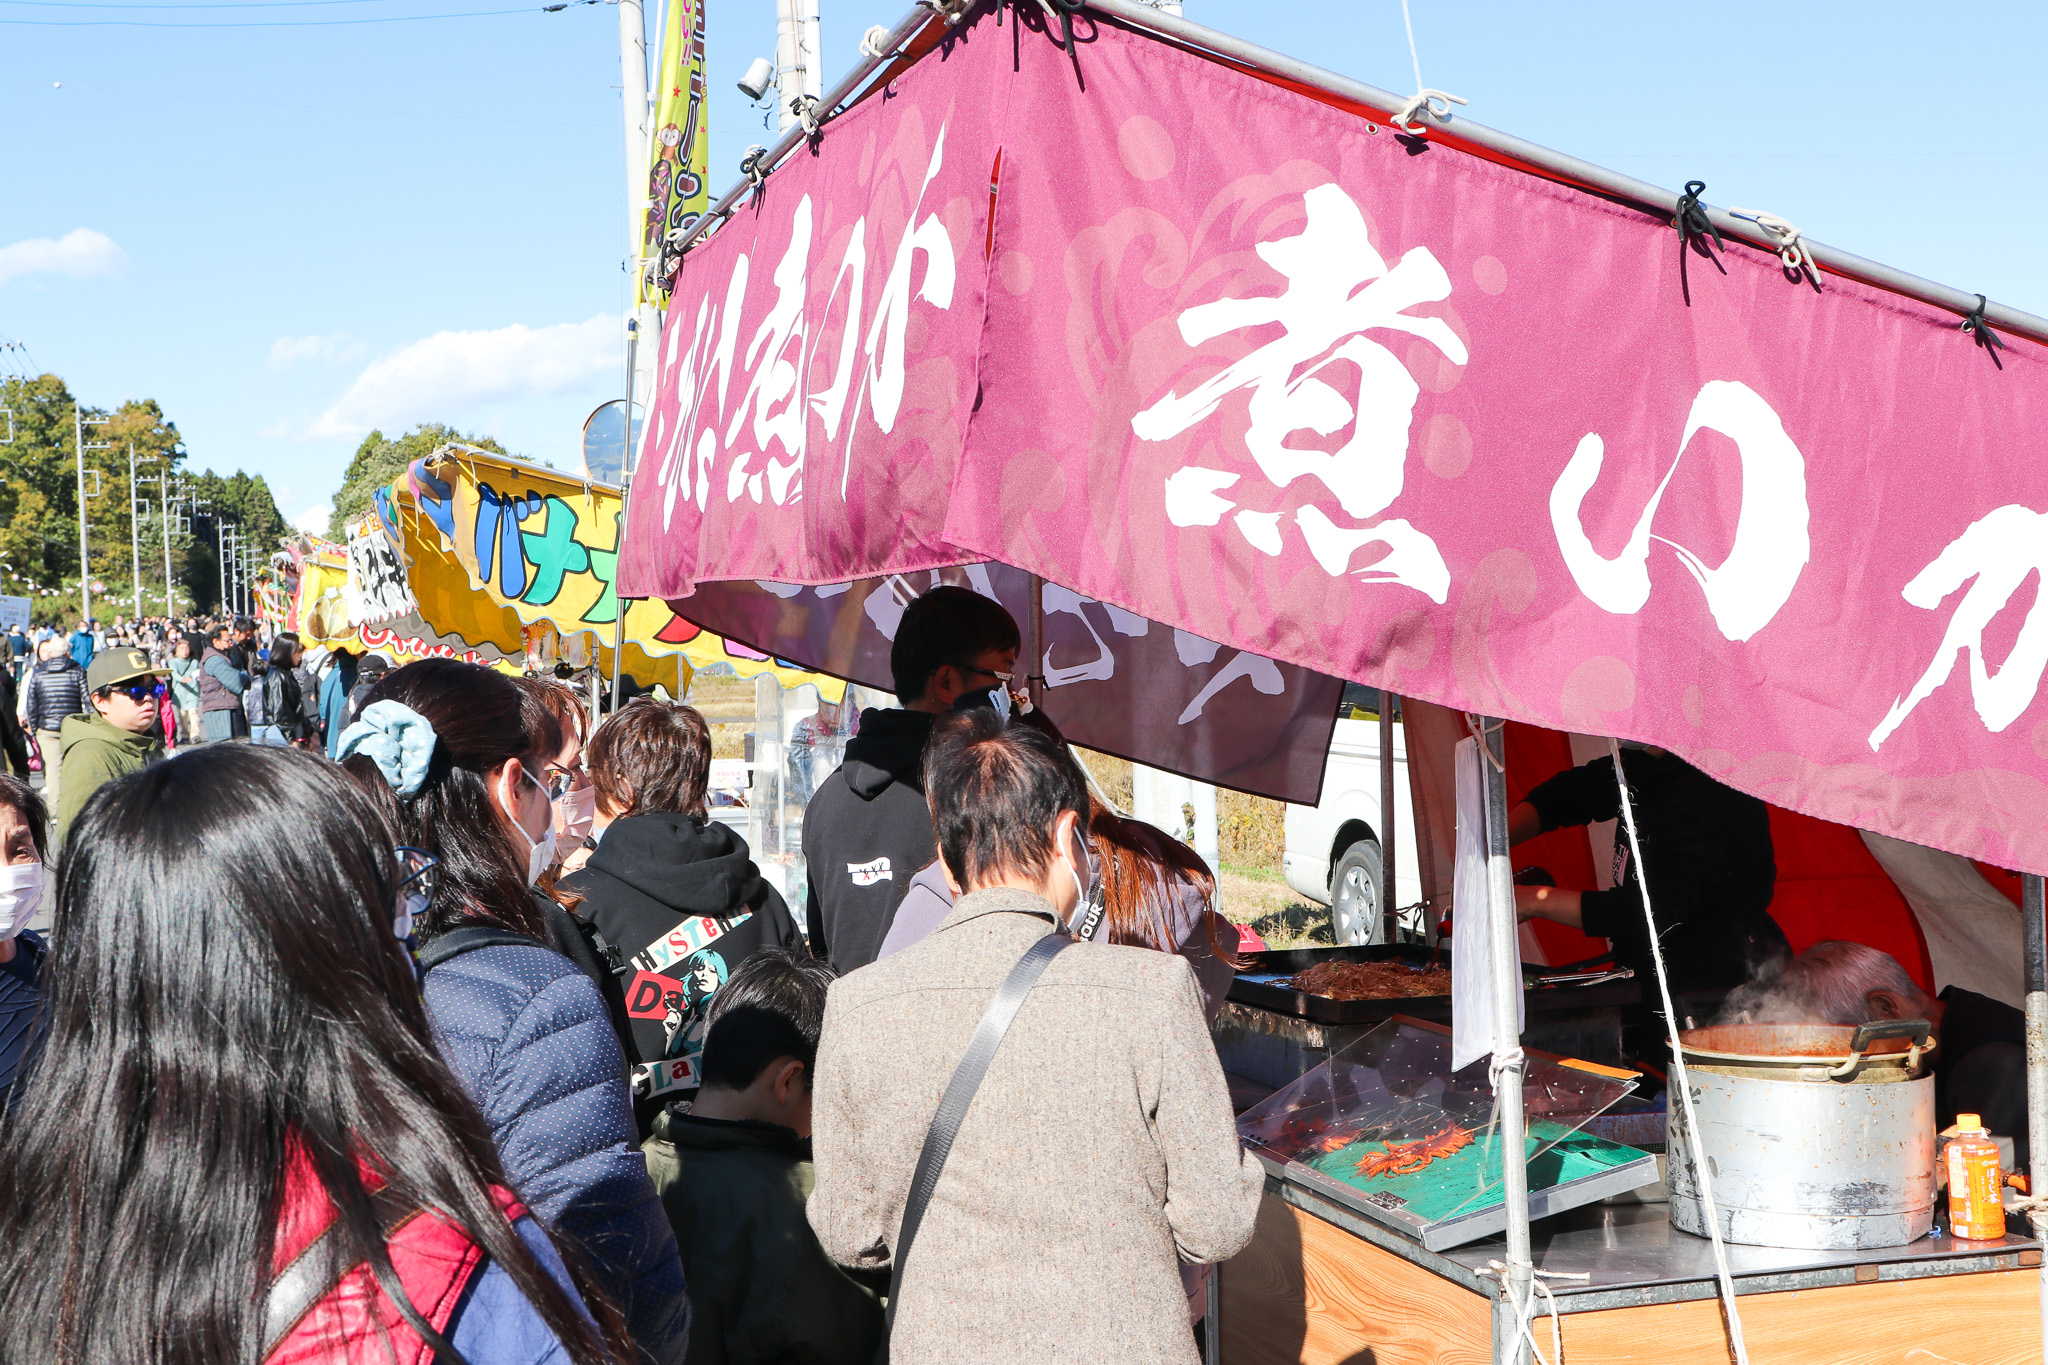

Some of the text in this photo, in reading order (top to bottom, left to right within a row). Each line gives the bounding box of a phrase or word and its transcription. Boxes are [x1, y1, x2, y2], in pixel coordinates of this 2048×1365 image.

[127, 651, 148, 670] C
[1986, 1167, 2001, 1204] ほうじ茶
